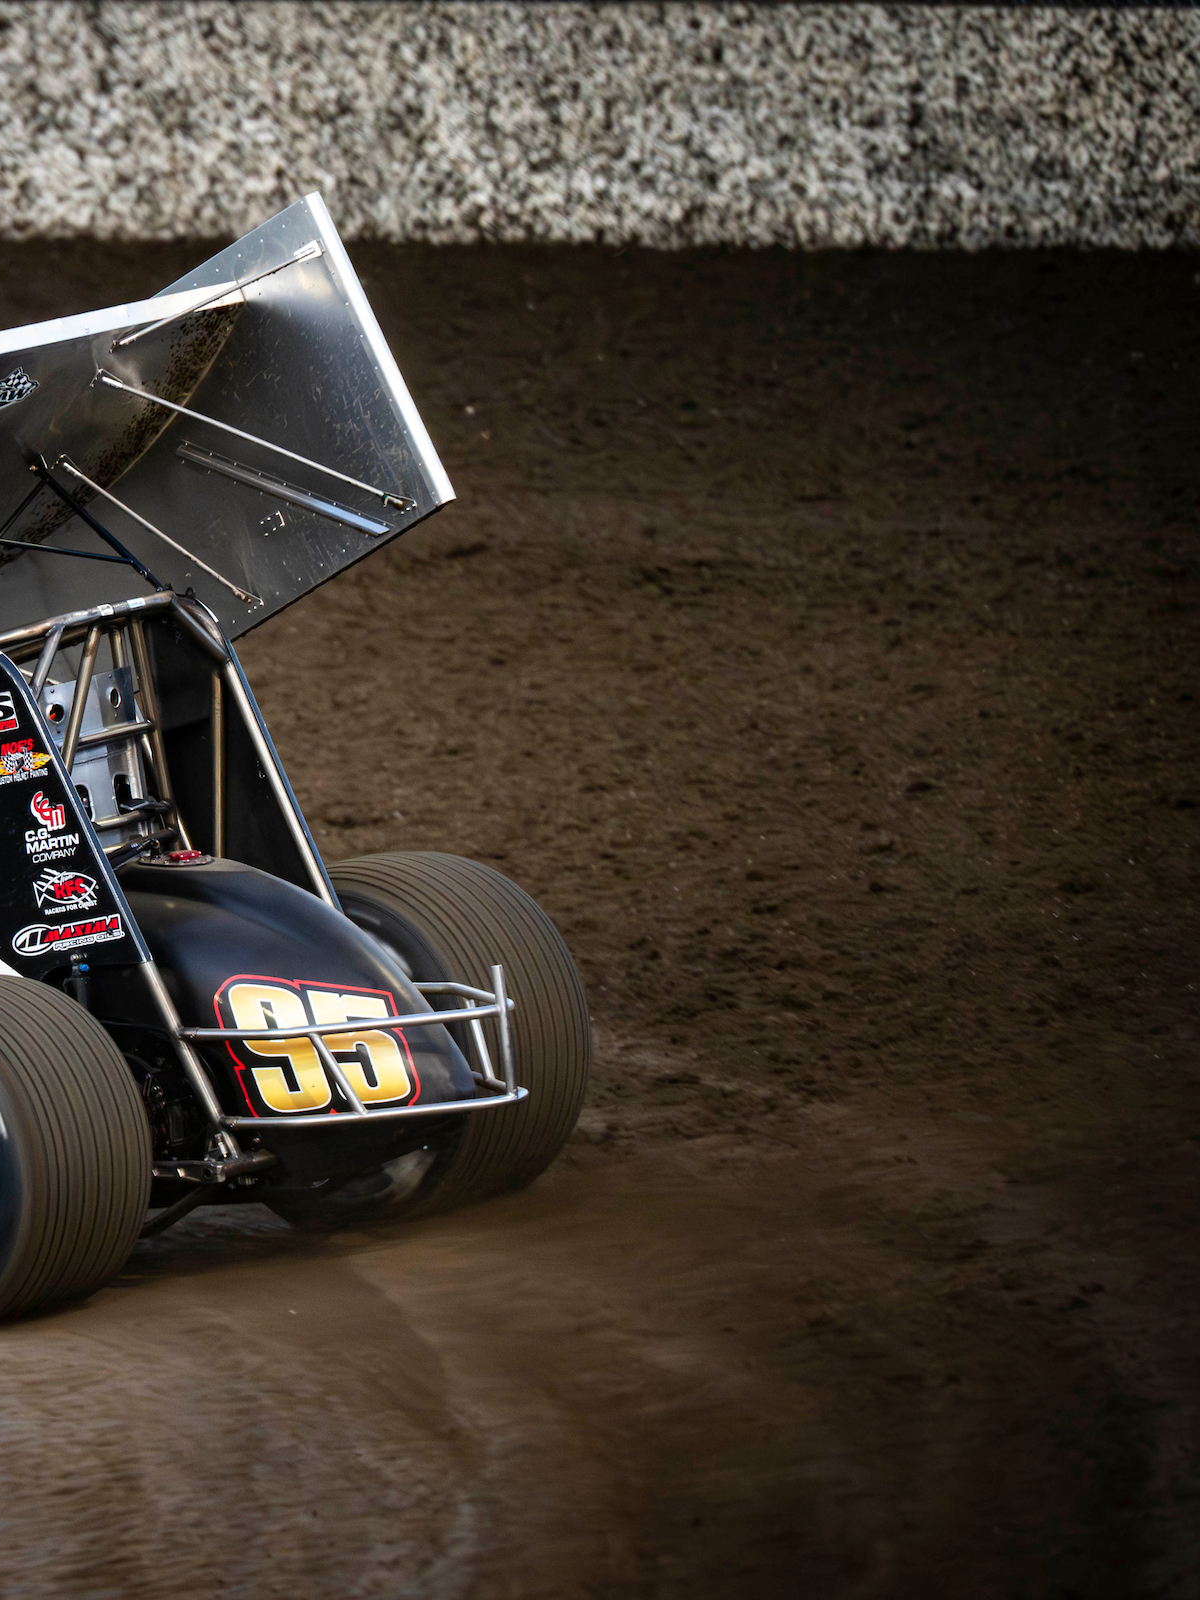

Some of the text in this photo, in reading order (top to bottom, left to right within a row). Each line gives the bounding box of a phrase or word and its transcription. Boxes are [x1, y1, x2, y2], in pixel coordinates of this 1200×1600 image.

[0, 738, 33, 757] MOE'S
[24, 827, 51, 843] C.G.
[25, 832, 79, 855] MARTIN
[32, 847, 77, 864] COMPANY
[53, 877, 86, 899] RFC
[44, 899, 98, 916] RACERS FOR CHRIST
[53, 935, 95, 950] RACING
[227, 983, 412, 1113] 95
